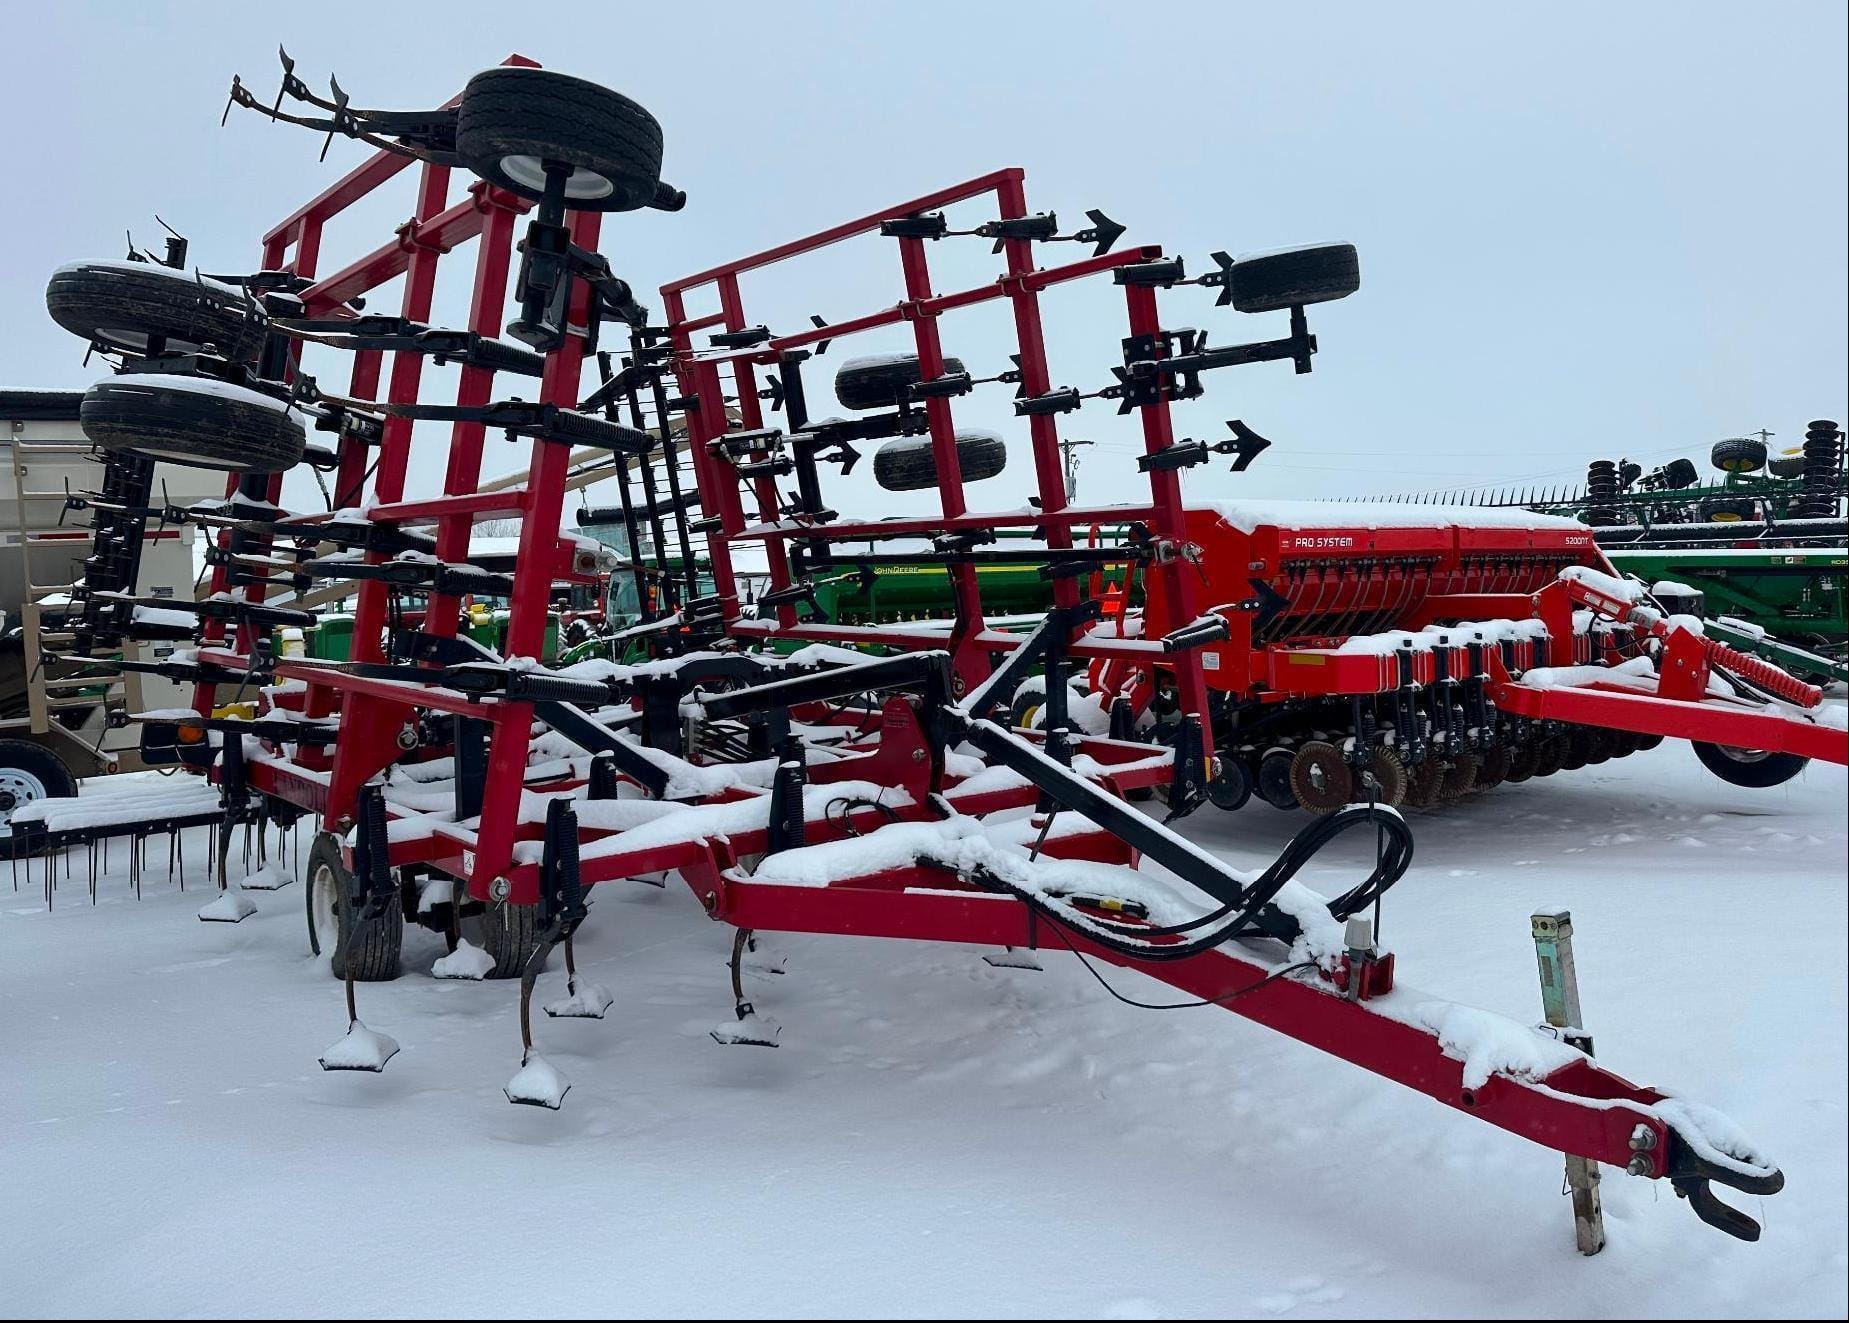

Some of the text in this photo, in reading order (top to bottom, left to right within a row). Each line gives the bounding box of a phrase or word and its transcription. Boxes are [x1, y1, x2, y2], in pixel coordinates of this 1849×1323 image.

[1295, 537, 1353, 548] PRO SYSTEM
[1565, 536, 1589, 545] 5200NT
[873, 566, 919, 575] JOHN DEERE
